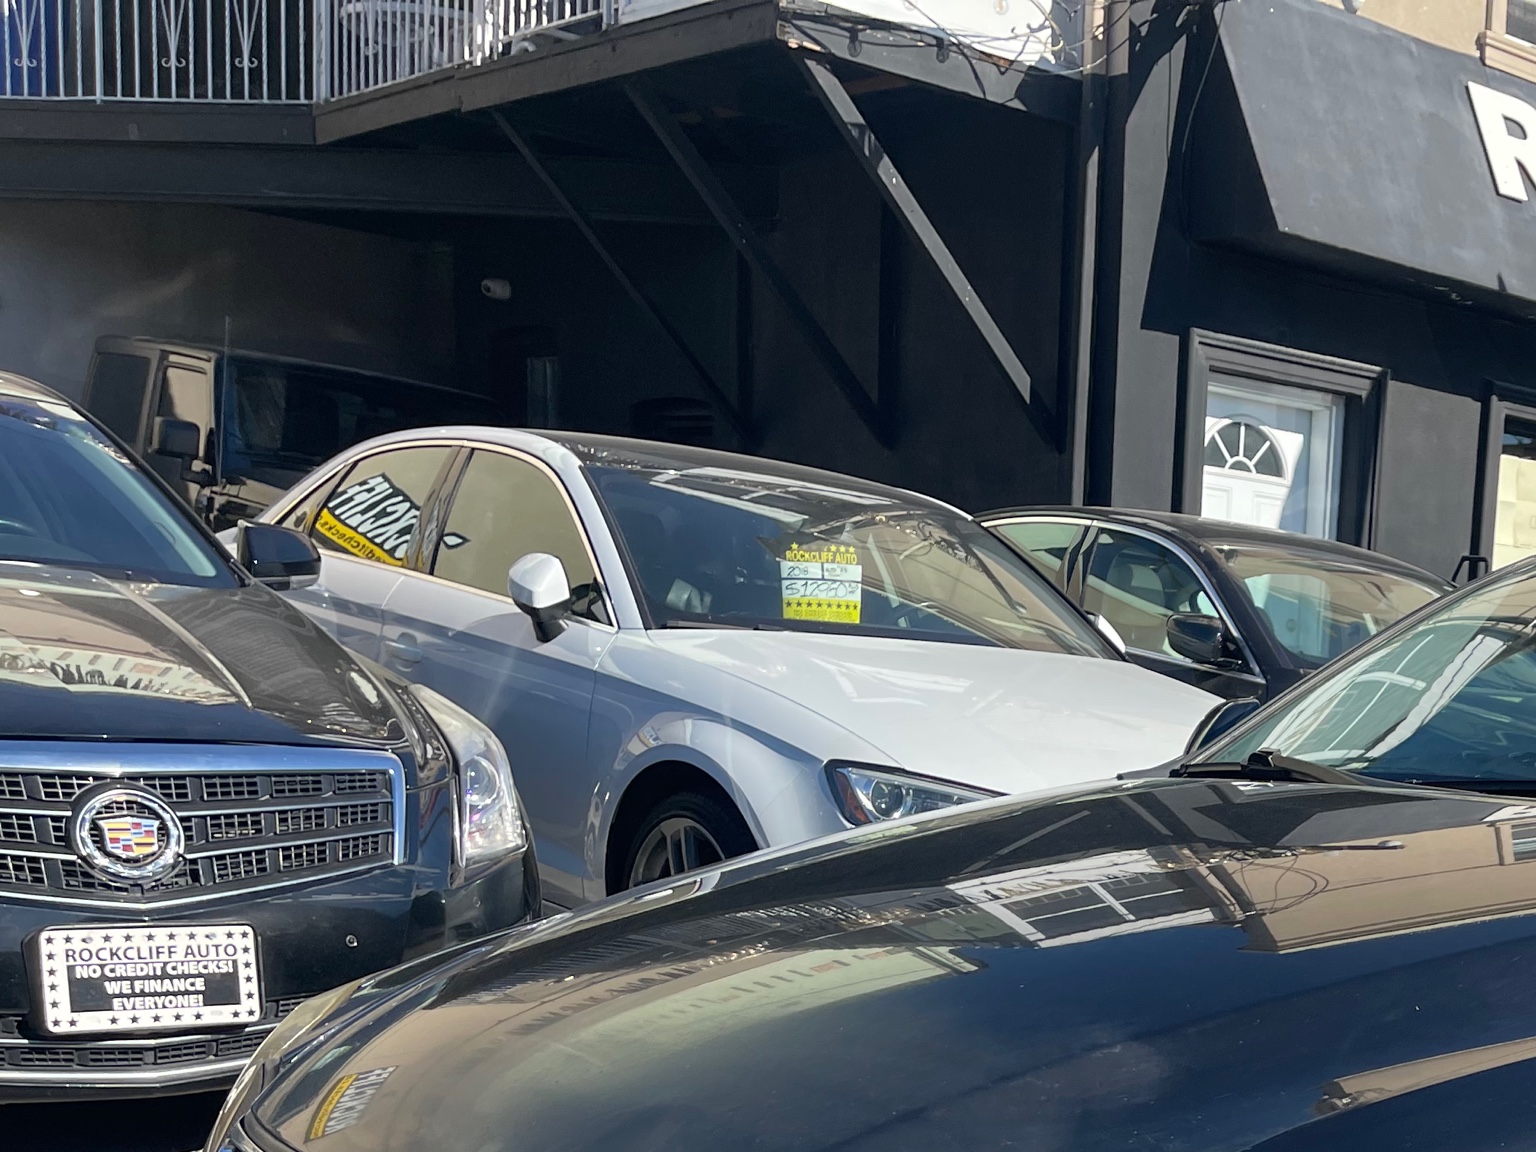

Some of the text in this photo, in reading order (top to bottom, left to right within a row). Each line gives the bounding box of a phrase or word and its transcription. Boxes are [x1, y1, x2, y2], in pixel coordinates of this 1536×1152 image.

[786, 550, 857, 564] ROCKCLIFF AUTO
[65, 943, 238, 963] ROCKCLIFF AUTO
[75, 960, 234, 979] NO CREDIT CHECKS!
[104, 977, 206, 995] WE FINANCE
[112, 994, 204, 1011] EVERYONE!
